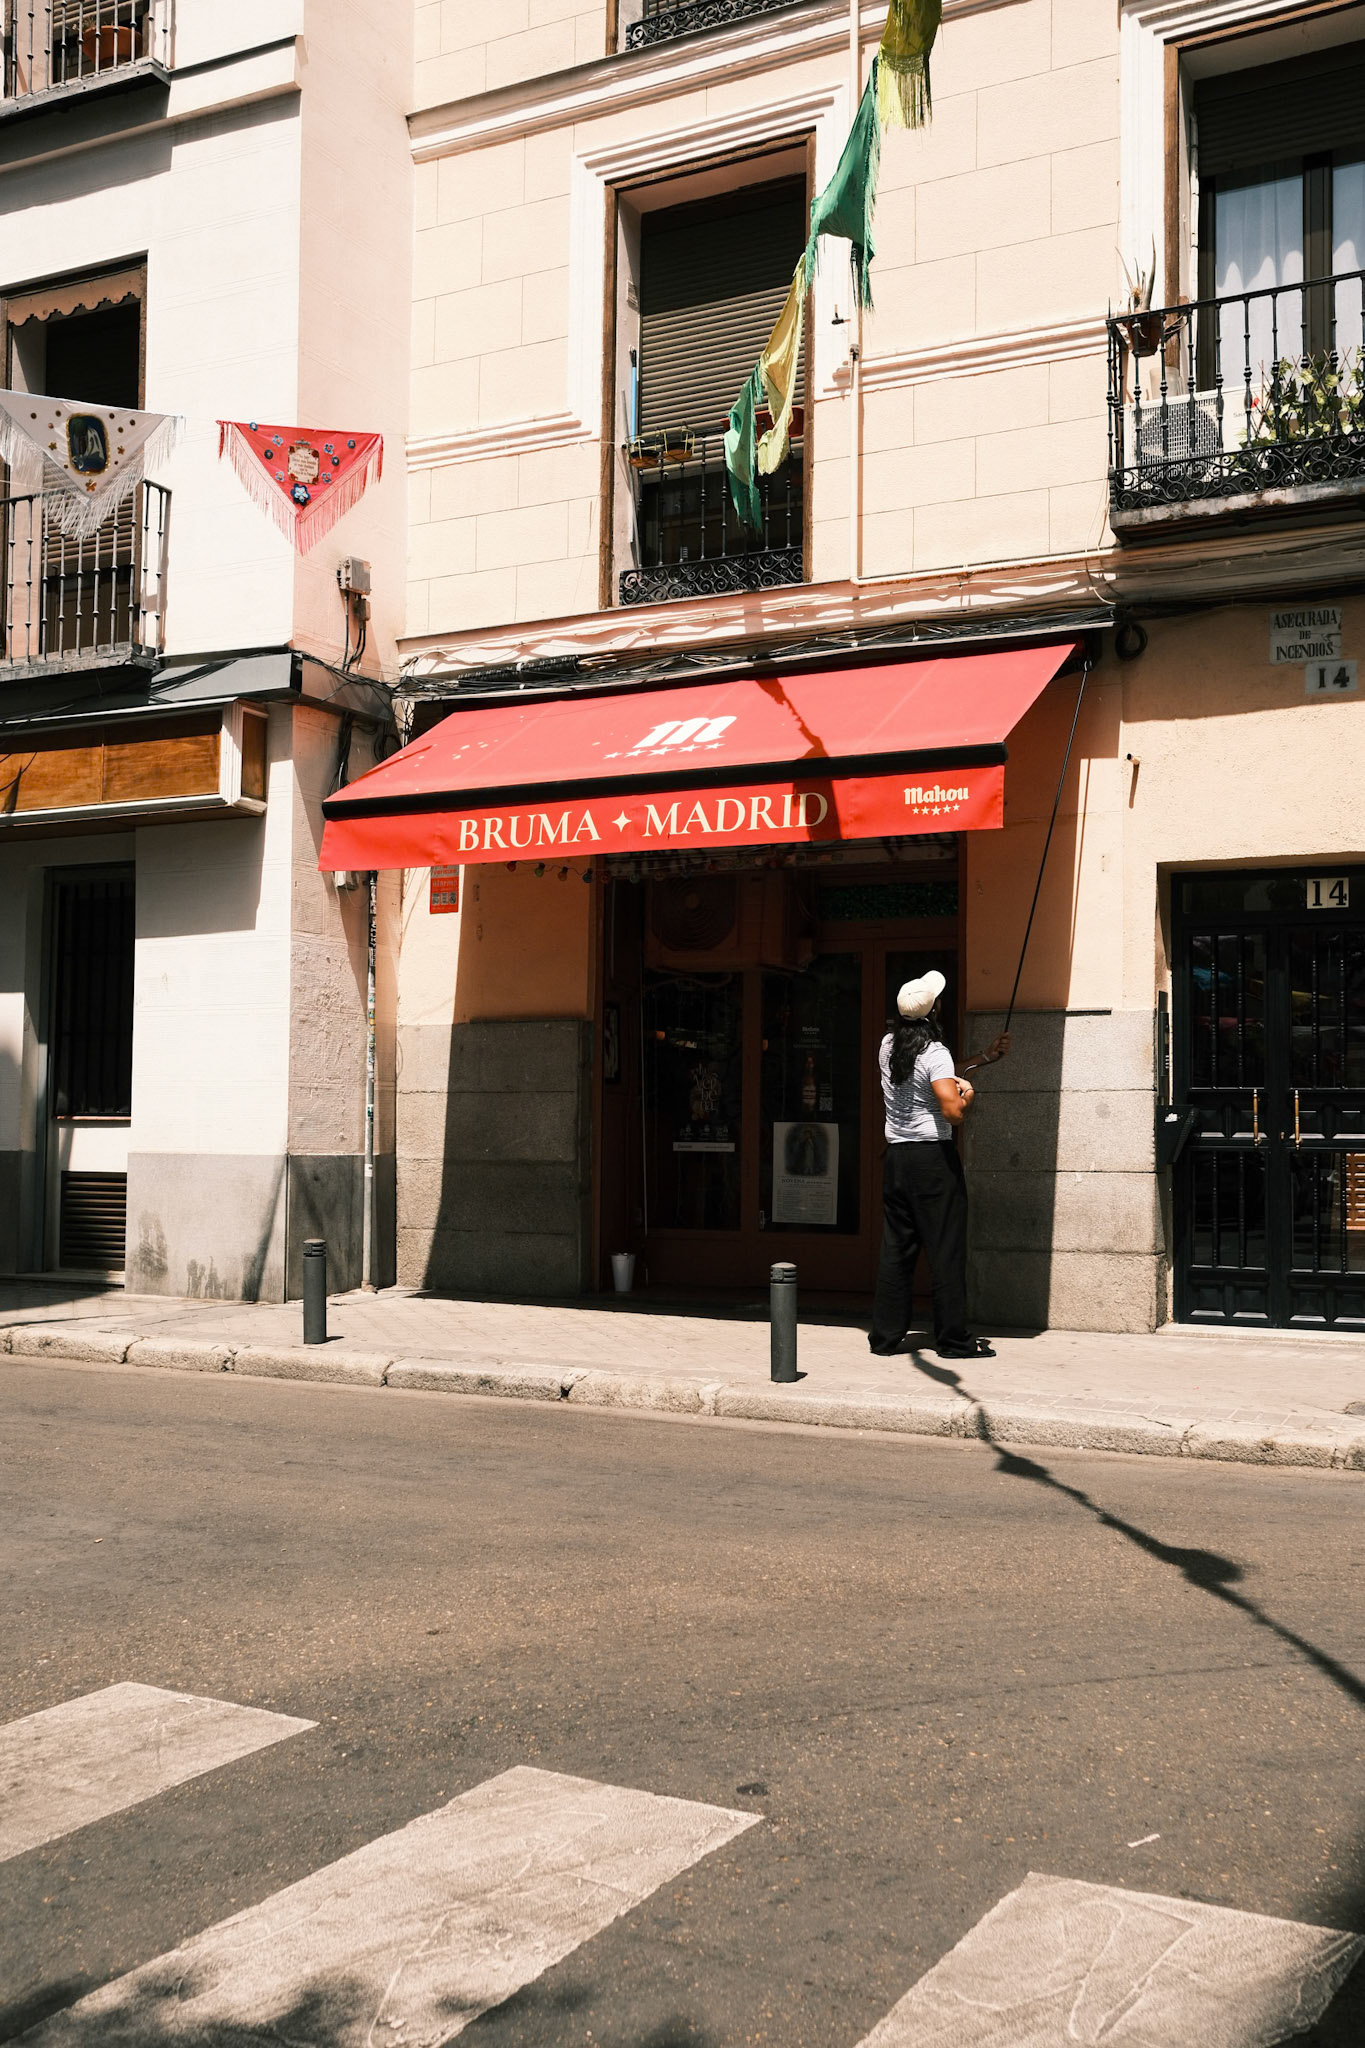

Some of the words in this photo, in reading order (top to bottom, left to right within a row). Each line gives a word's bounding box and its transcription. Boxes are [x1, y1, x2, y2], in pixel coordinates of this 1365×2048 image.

[1273, 609, 1337, 629] ASEGURADA
[1299, 630, 1312, 640] DE
[1276, 641, 1334, 661] INCENDIOS
[1318, 666, 1350, 690] 14
[903, 785, 970, 805] Mahou
[457, 808, 602, 852] BRUMA
[641, 792, 828, 838] MADRID
[1312, 880, 1347, 907] 14
